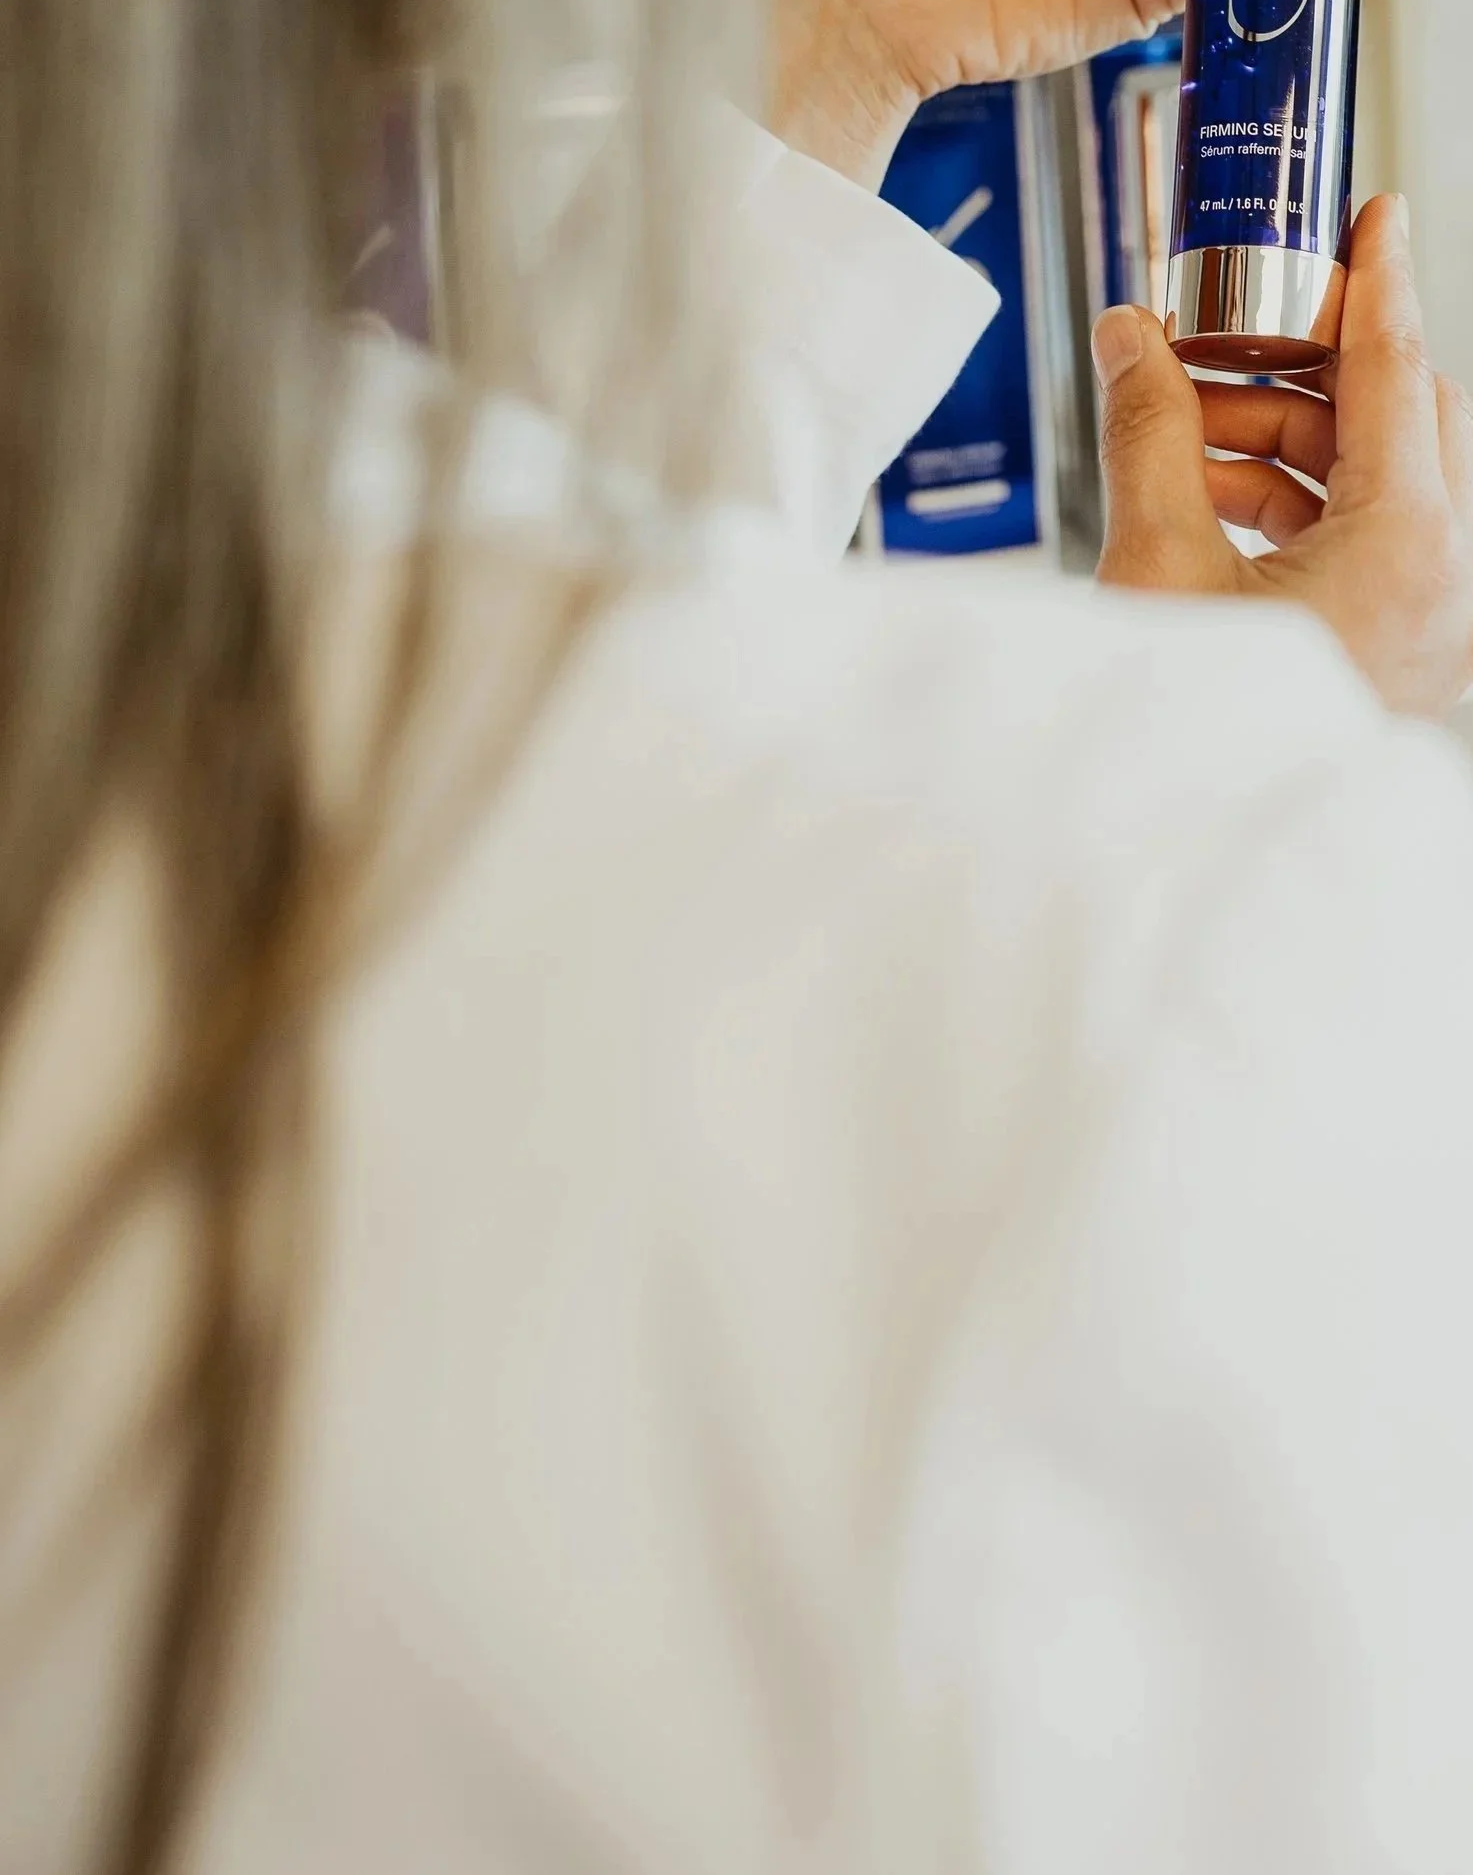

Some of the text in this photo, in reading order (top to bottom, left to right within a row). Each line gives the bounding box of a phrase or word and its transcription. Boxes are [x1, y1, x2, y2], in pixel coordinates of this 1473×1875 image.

[1200, 122, 1317, 142] FIRMING SEUM
[1200, 144, 1235, 158] Sérum
[1200, 200, 1210, 211] 47
[1212, 198, 1227, 210] mL
[1236, 198, 1251, 210] 1.6
